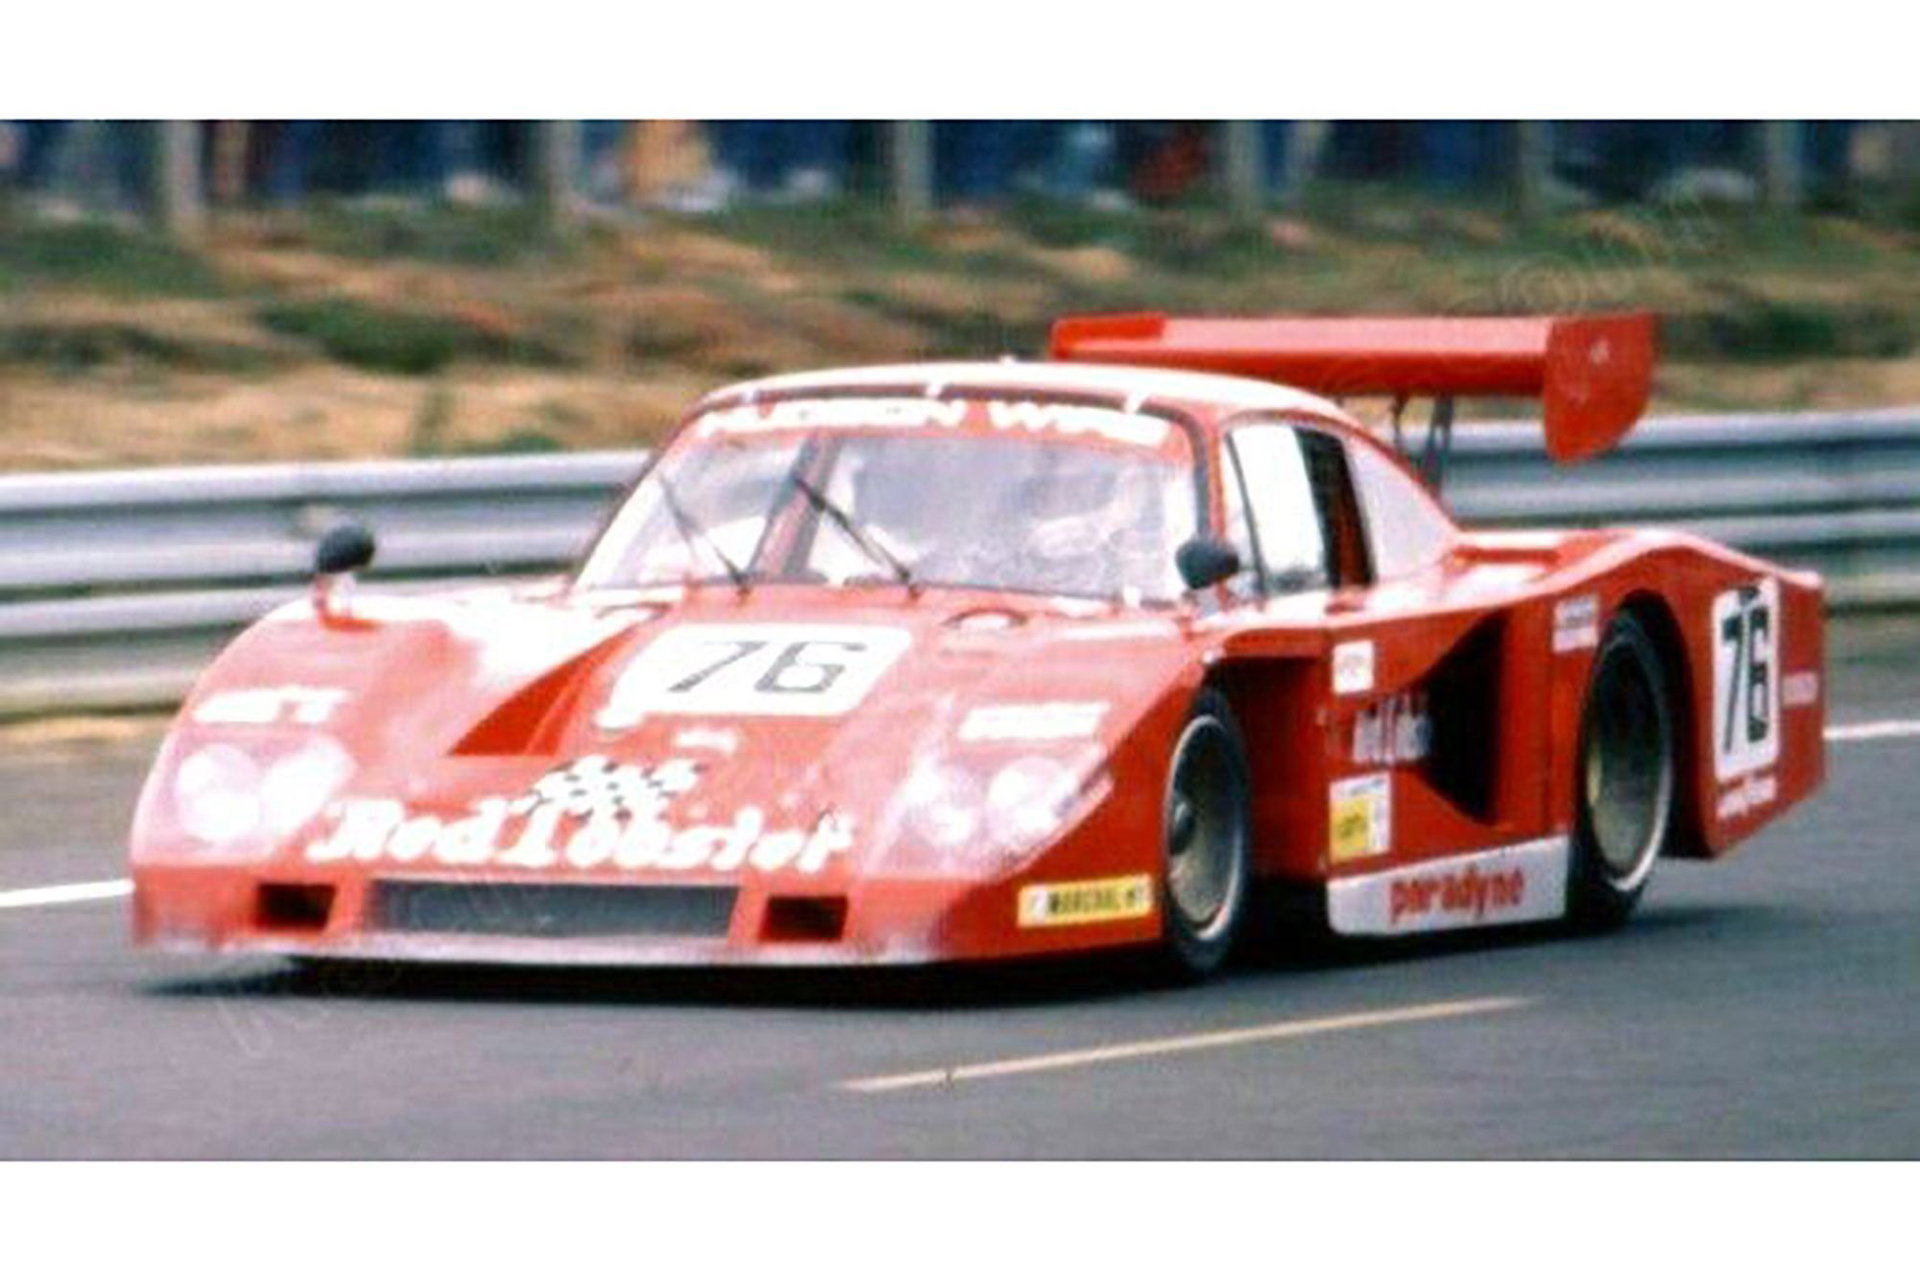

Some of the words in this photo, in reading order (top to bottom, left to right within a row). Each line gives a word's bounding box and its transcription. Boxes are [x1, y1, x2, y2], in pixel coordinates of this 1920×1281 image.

[666, 640, 867, 693] 76
[1721, 586, 1770, 755] 76
[308, 799, 509, 862] Red
